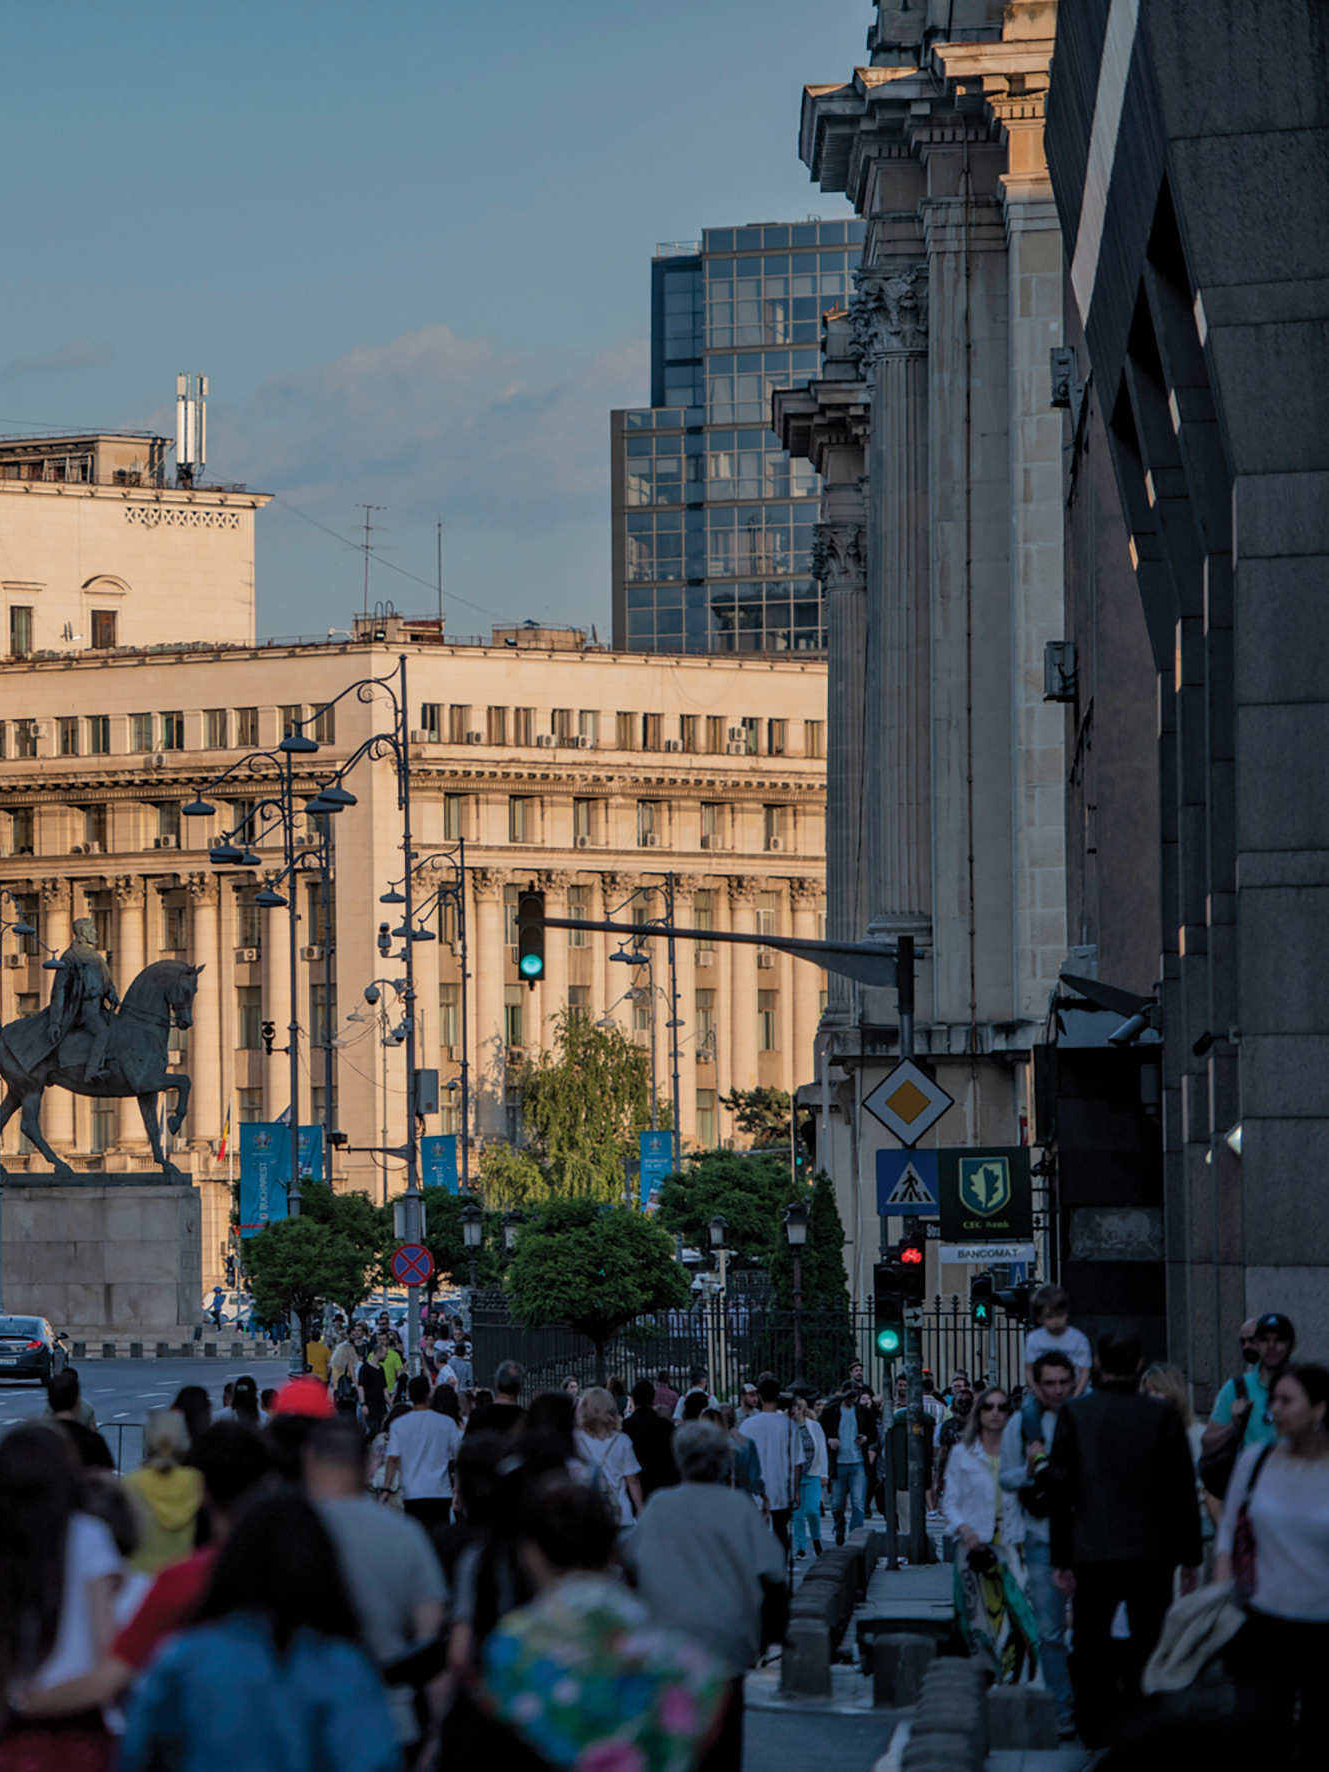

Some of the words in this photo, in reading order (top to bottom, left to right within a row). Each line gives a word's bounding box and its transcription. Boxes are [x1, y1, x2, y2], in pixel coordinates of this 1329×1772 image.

[259, 1162, 268, 1211] BUCHAREST
[962, 1220, 983, 1229] CEC
[985, 1220, 1010, 1229] Bank
[957, 1248, 1019, 1259] BANCOMAT
